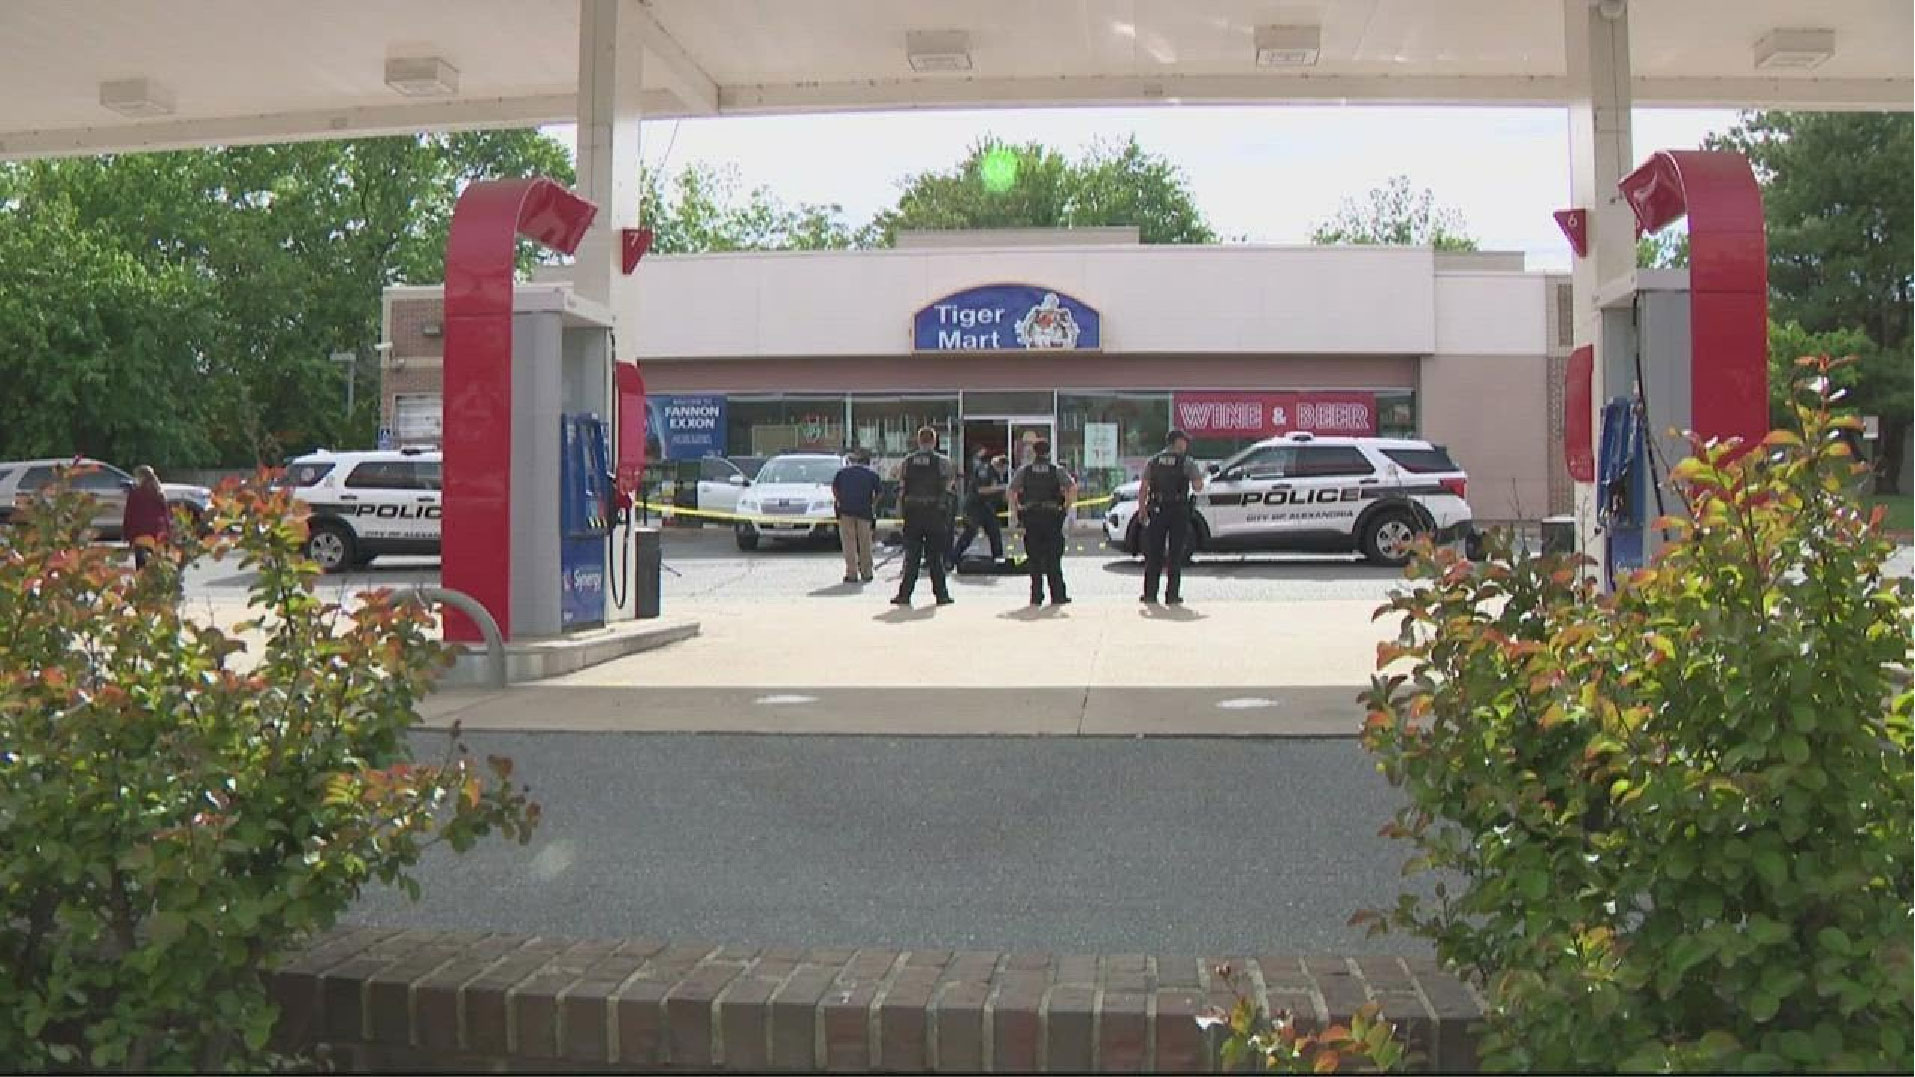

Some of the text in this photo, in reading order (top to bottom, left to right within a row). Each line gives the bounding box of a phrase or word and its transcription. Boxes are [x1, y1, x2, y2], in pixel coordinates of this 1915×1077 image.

[1567, 213, 1578, 228] 6
[629, 232, 639, 247] 7
[934, 304, 1005, 328] Tiger
[938, 329, 1000, 350] Mart
[664, 405, 720, 417] FANNON
[1179, 401, 1370, 430] WINE & BEER
[669, 418, 716, 429] EXXON
[1240, 486, 1360, 508] POLICE
[356, 503, 442, 519] POLIC
